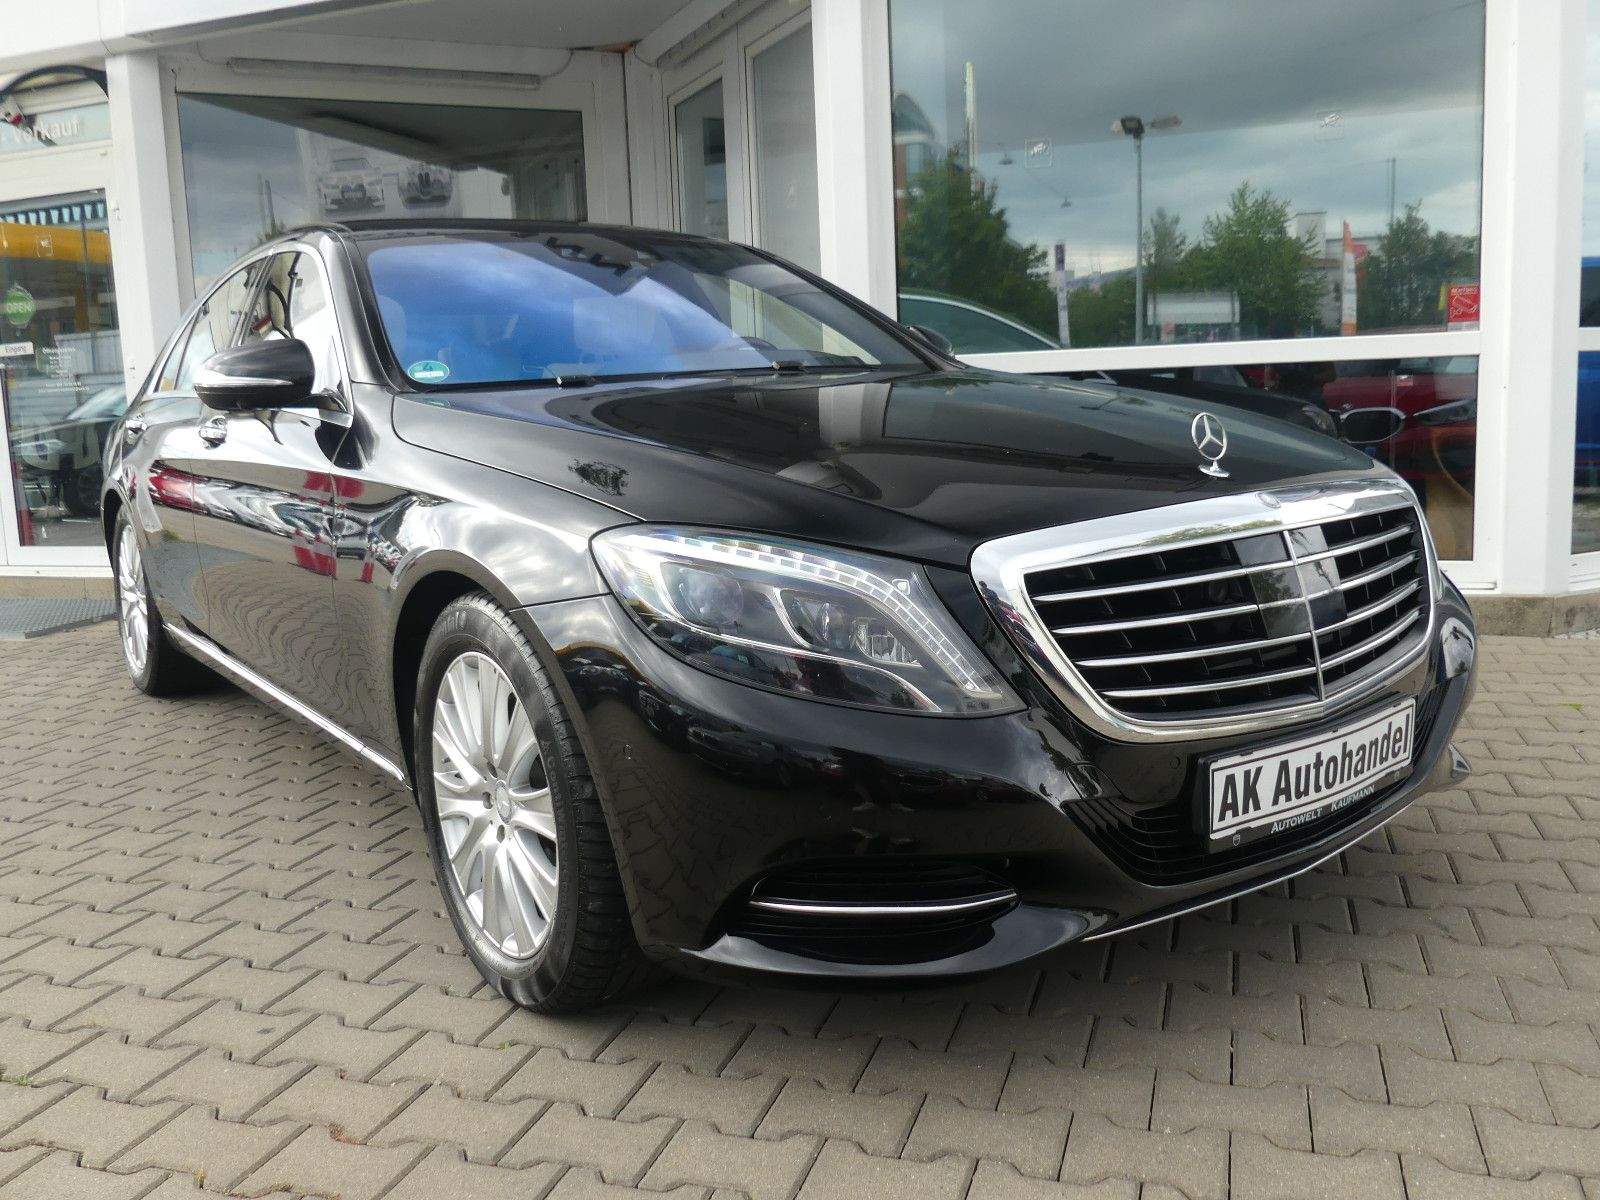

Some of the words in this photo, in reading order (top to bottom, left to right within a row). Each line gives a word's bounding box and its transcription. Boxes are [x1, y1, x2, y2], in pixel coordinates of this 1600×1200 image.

[1218, 766, 1263, 822] AK
[1272, 713, 1410, 806] Autohandel
[1270, 808, 1324, 834] AUTOWELT
[1330, 784, 1375, 812] KAUFMANN
